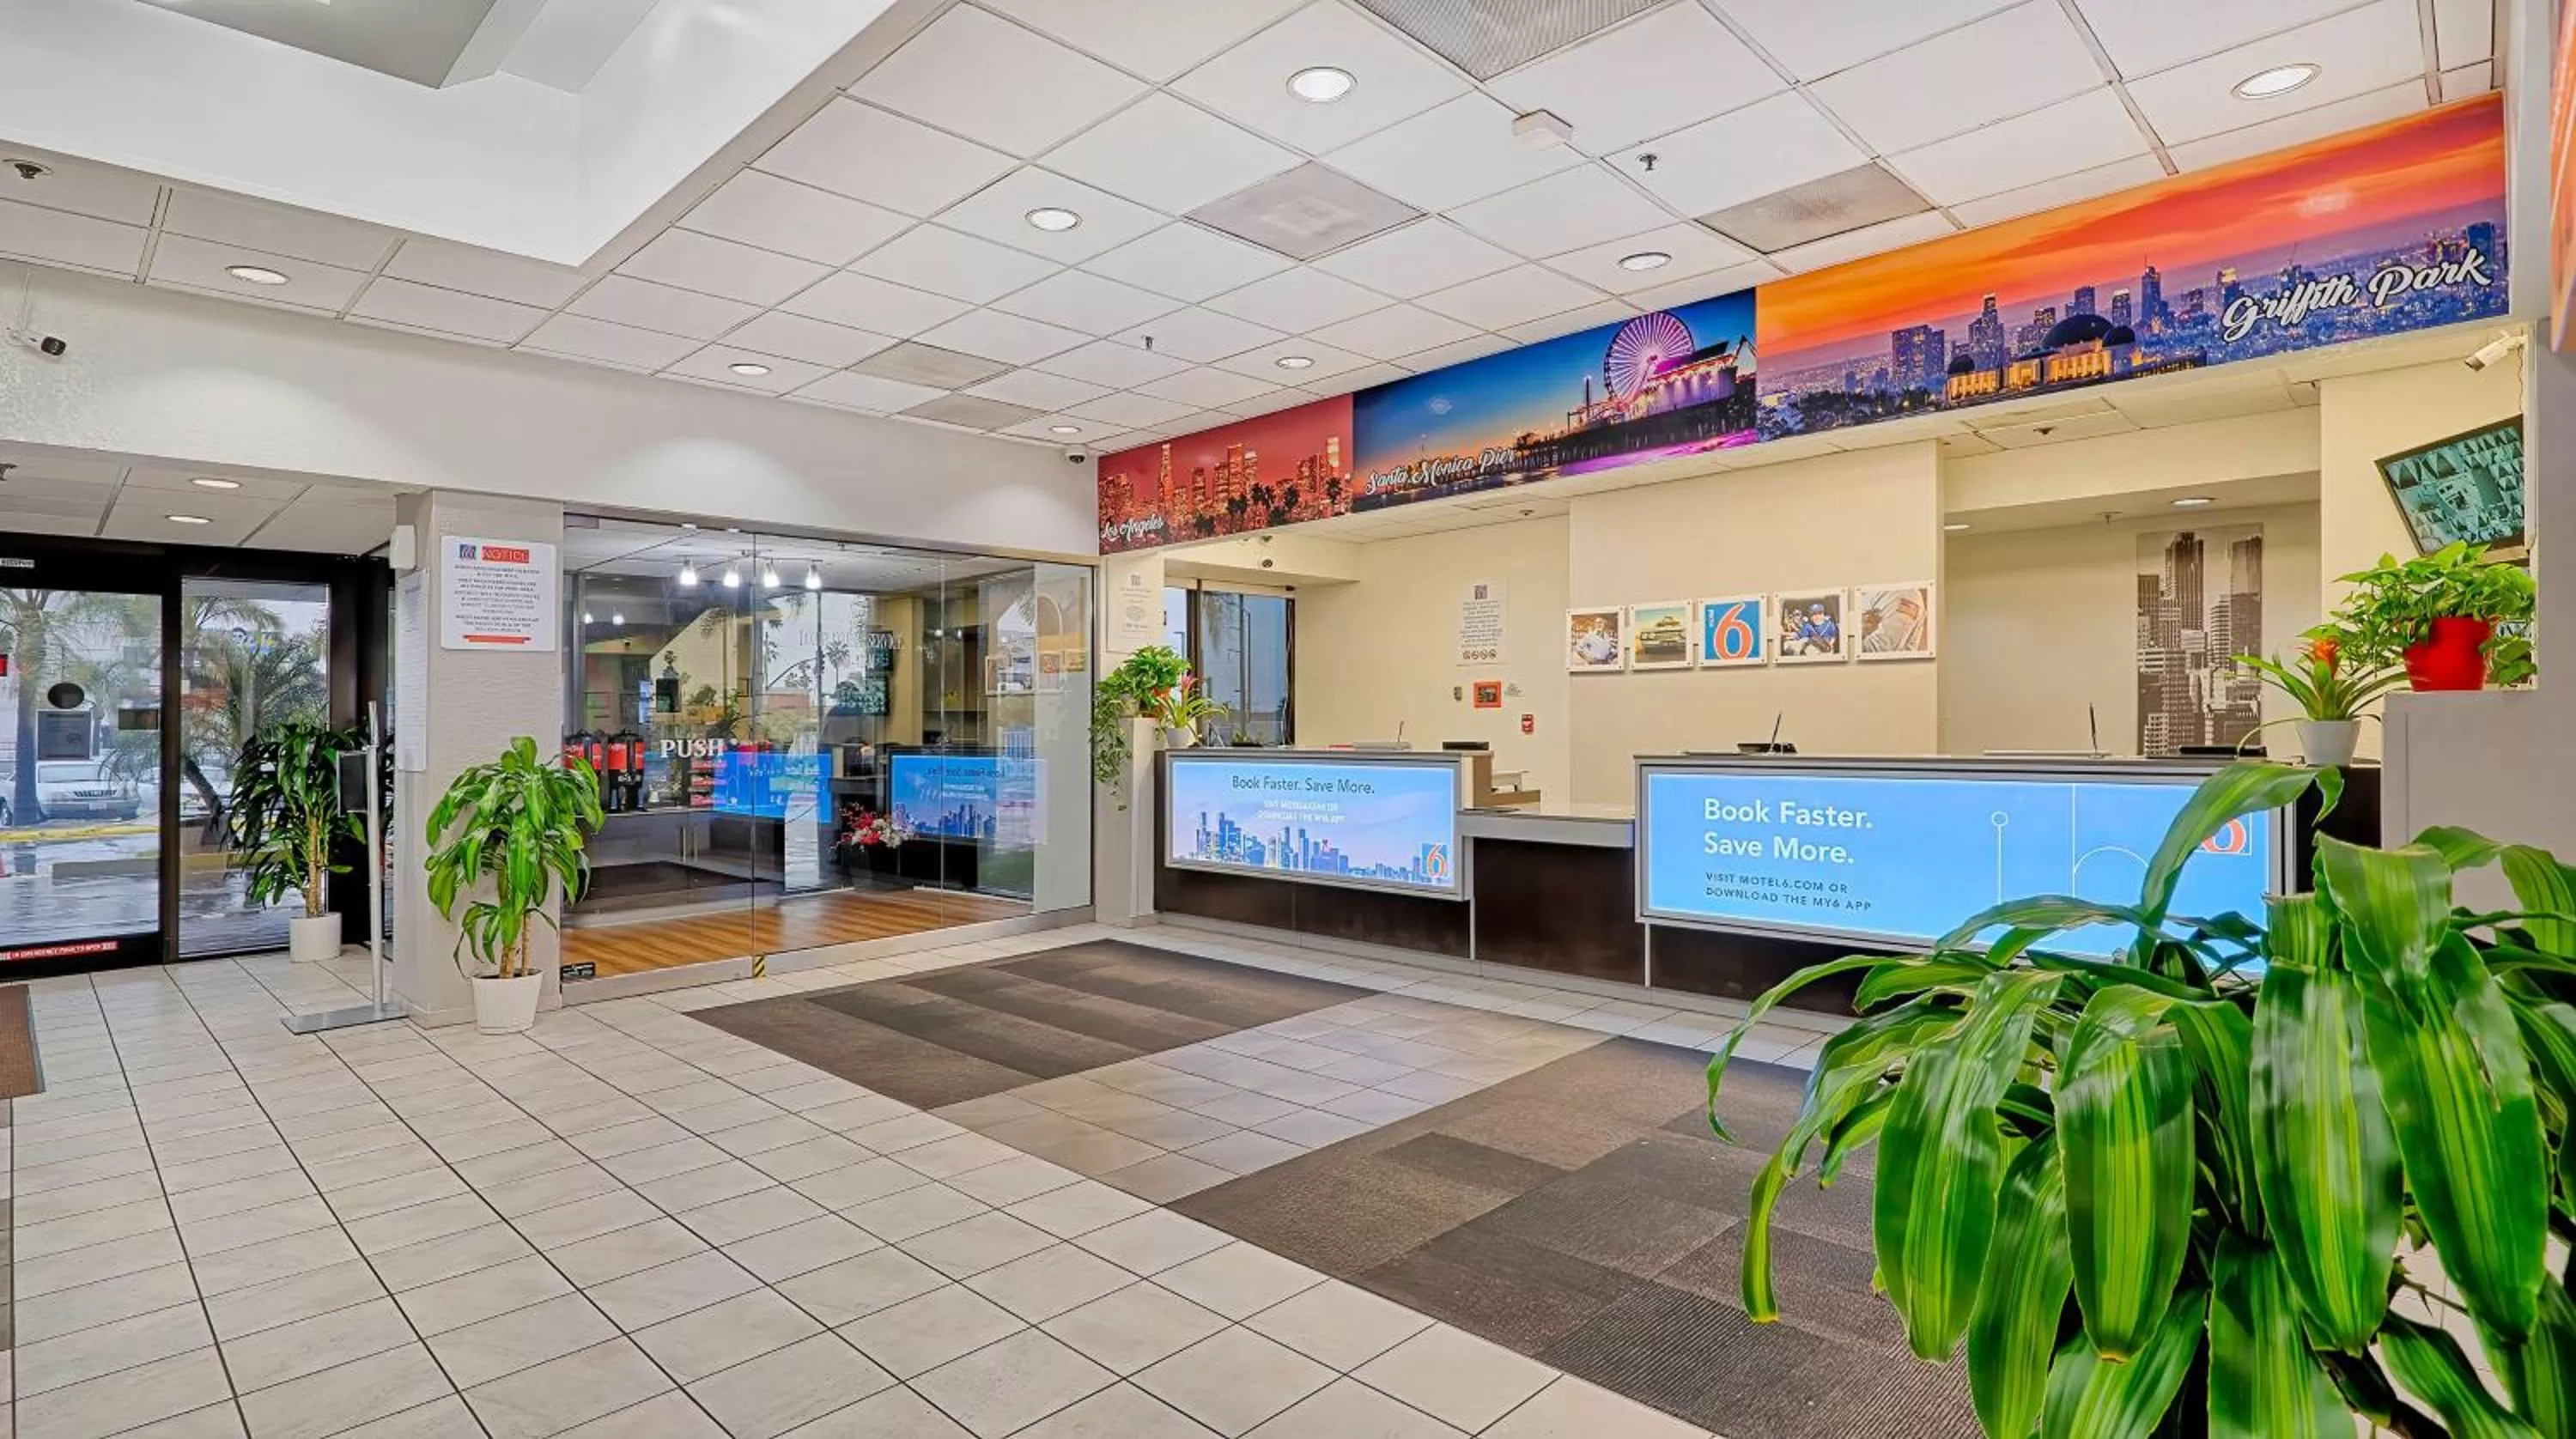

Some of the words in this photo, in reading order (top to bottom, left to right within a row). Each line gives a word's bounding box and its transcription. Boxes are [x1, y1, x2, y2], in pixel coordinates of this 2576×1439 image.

[2222, 275, 2360, 342] Griffith
[2367, 248, 2492, 307] Park
[1365, 467, 1407, 495] Santa
[1409, 457, 1474, 487] Monica
[1479, 448, 1516, 473] Pier
[1101, 521, 1120, 542] Los
[1120, 513, 1164, 542] Angeles
[1714, 602, 1753, 659] 6
[659, 738, 724, 758] PUSH
[1232, 775, 1260, 789] Book
[1263, 776, 1301, 791] Faster.
[1304, 777, 1334, 792] Save
[1338, 779, 1375, 794] More.
[1704, 797, 1771, 823] Book
[1779, 800, 1873, 829] Faster.
[1427, 842, 1448, 878] 6
[1704, 831, 1763, 857] Save
[1773, 835, 1855, 865] More.
[1705, 872, 1735, 883] VISIT
[1739, 875, 1823, 892] MOTEL6.COM
[1828, 883, 1848, 894] OR
[1705, 887, 1778, 902] DOWNLOAD
[1783, 894, 1807, 906] THE
[1813, 897, 1840, 908] MY6
[1845, 901, 1872, 911] APP
